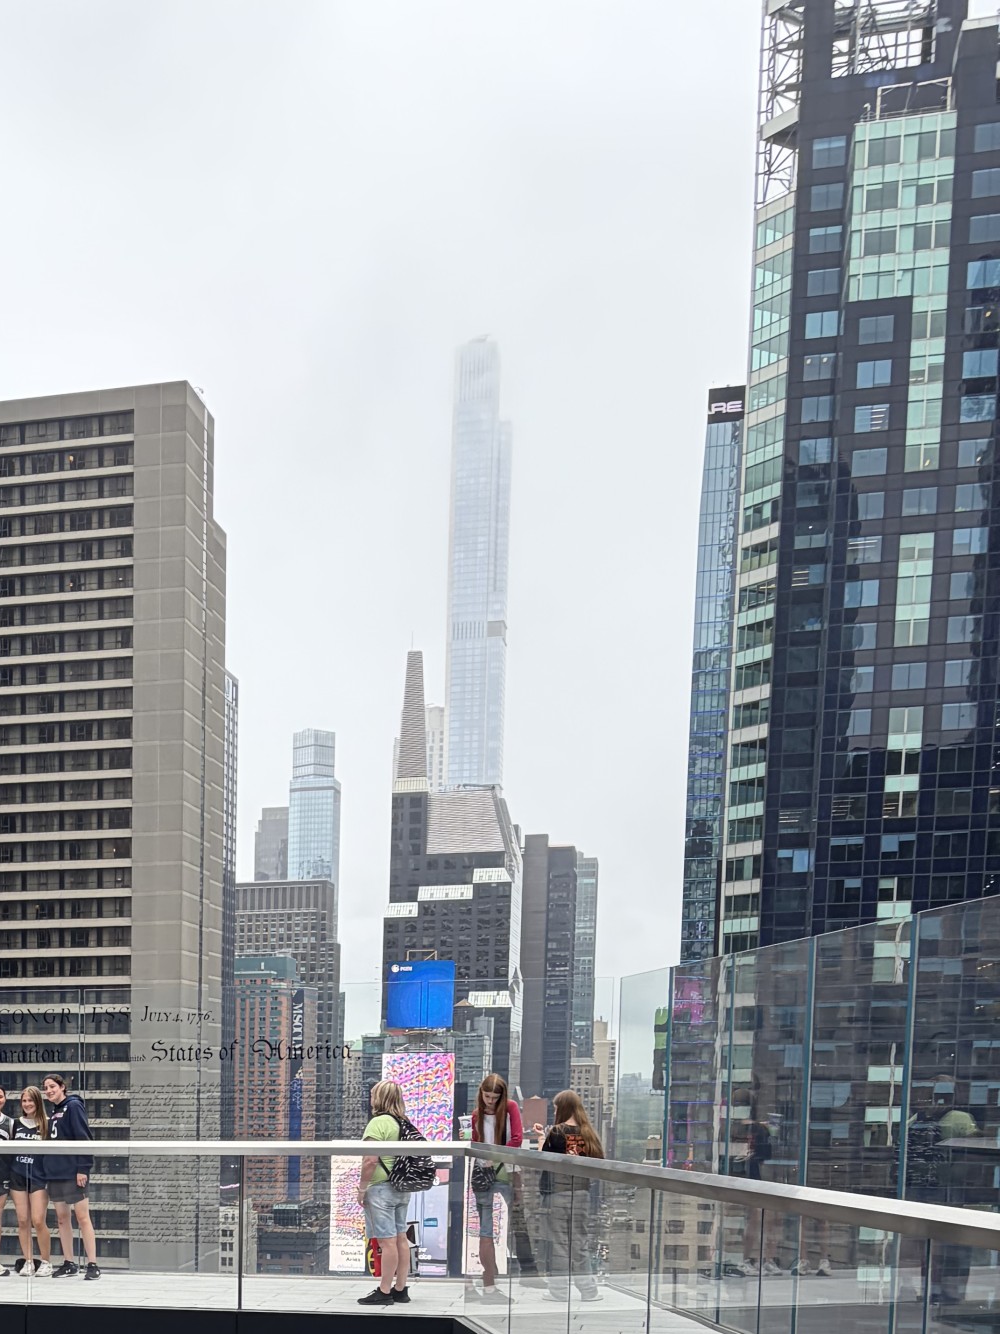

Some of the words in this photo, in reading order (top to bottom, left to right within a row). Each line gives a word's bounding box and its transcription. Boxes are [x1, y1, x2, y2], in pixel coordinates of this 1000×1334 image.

[141, 1005, 172, 1022] JULY
[187, 1010, 215, 1024] 1776.
[150, 1039, 213, 1062] States
[219, 1039, 239, 1062] of
